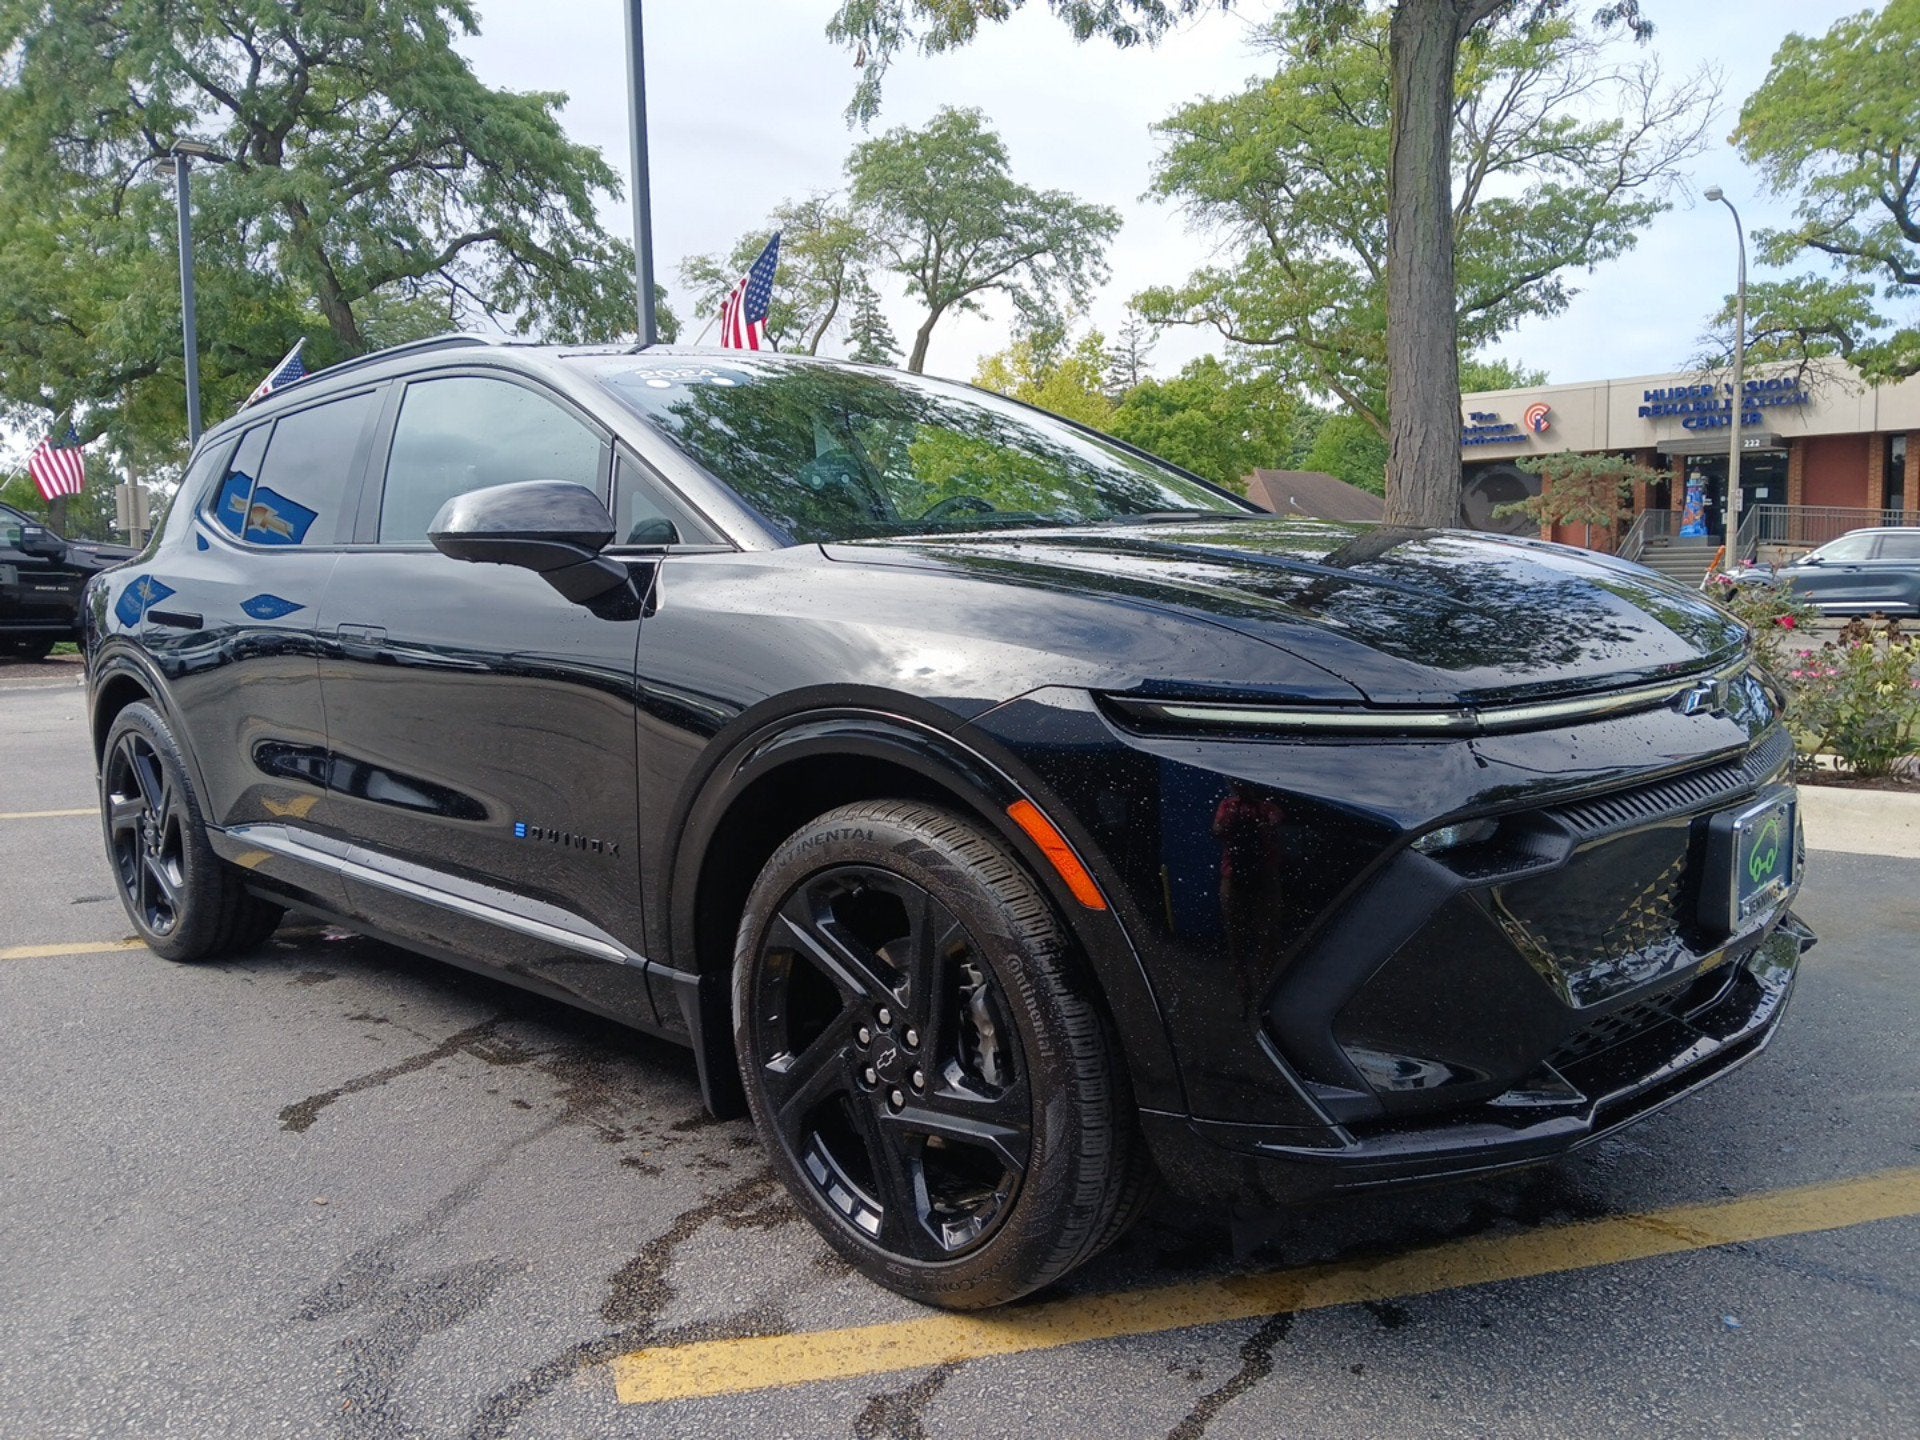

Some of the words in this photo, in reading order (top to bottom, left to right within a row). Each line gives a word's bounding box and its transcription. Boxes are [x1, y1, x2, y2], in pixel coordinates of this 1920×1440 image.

[1644, 384, 1714, 402] HUBER
[1468, 412, 1497, 421] The
[1744, 439, 1760, 447] 222
